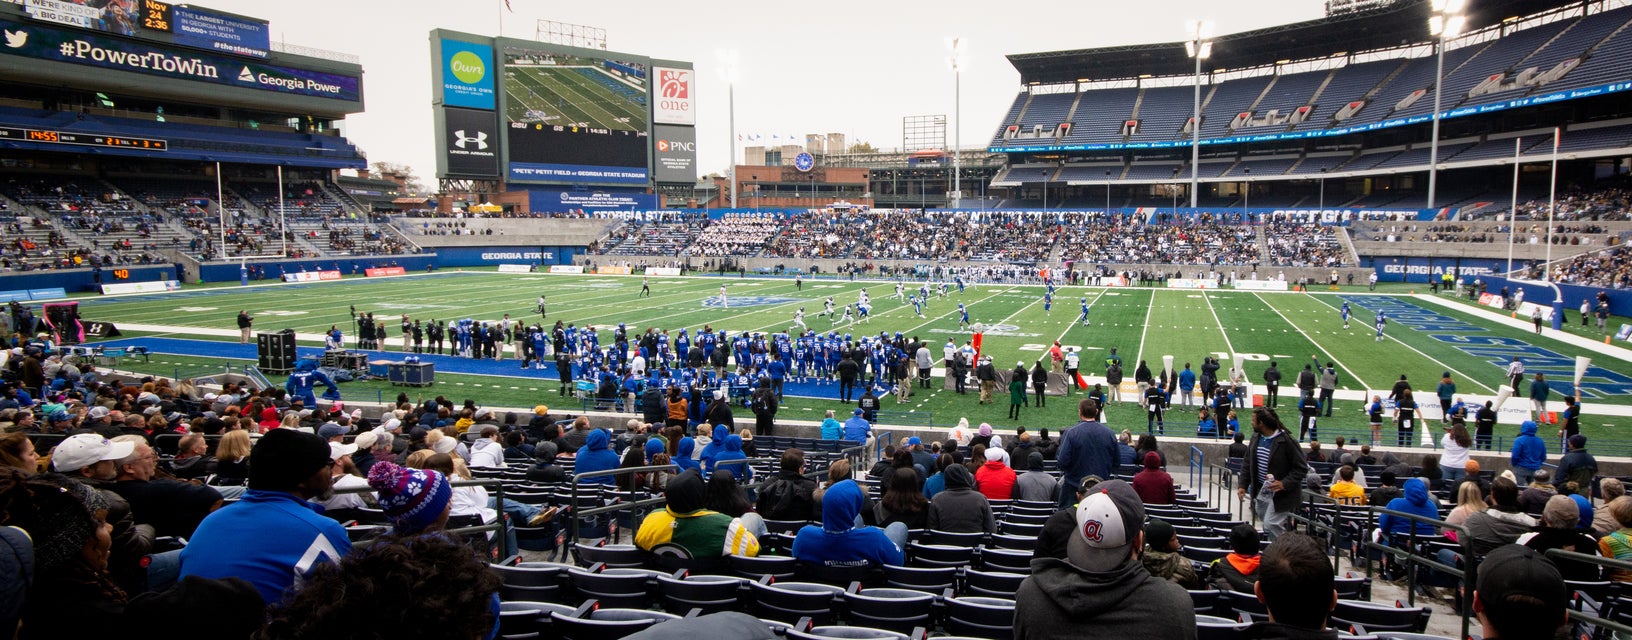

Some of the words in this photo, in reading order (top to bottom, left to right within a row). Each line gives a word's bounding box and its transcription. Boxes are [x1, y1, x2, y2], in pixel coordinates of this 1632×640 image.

[32, 0, 60, 9] WE'RE
[61, 3, 83, 14] KIND
[145, 0, 167, 11] Nov
[41, 11, 56, 20] BIG
[58, 15, 82, 25] DEAL
[149, 10, 163, 20] 24
[145, 19, 168, 30] 2:35
[189, 20, 217, 30] GEORGIA
[219, 25, 234, 33] WITH
[195, 14, 225, 25] LARGEST
[226, 20, 260, 32] UNIVERSITY
[181, 25, 207, 34] 50,000+
[209, 30, 240, 40] STUDENTS
[214, 42, 267, 57] #thestateway
[59, 39, 219, 79] #PowerToWin
[453, 60, 482, 75] Own
[258, 73, 304, 90] Georgia
[307, 79, 341, 93] Power
[661, 100, 689, 112] one
[30, 131, 57, 142] 14:55
[670, 141, 696, 152] PNC
[482, 252, 522, 260] GEORGIA
[523, 252, 553, 260] STATE
[115, 269, 129, 279] 40
[1384, 264, 1443, 274] GEORGIA
[1083, 519, 1103, 543] a
